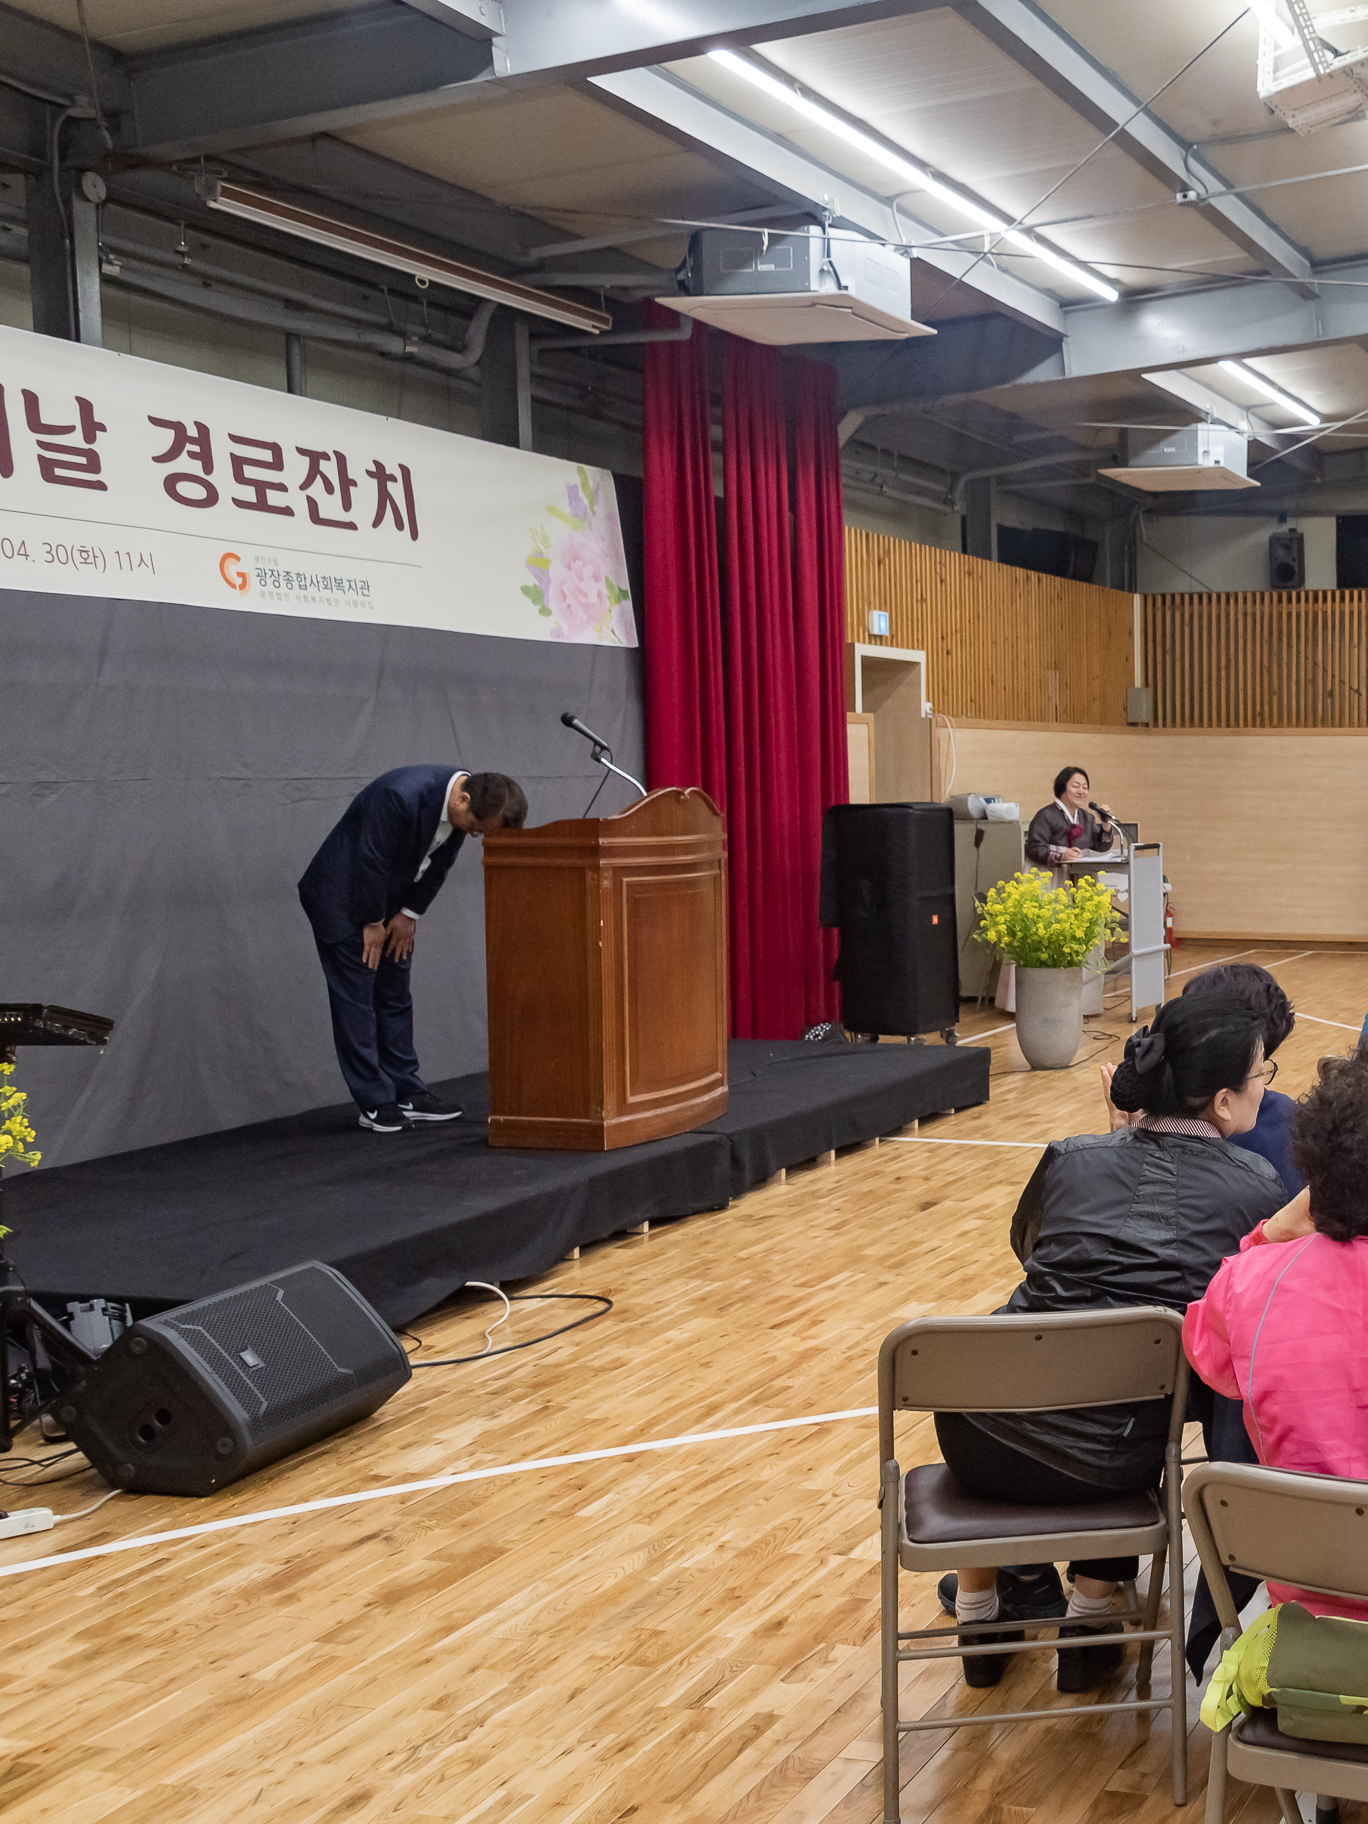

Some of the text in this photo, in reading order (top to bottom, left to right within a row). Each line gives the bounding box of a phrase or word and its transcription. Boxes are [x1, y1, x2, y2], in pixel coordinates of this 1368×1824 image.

[147, 414, 418, 541] 경로잔치
[1, 537, 156, 575] 04. 30(화) 11시
[255, 567, 370, 597] 광장종합사회복지관
